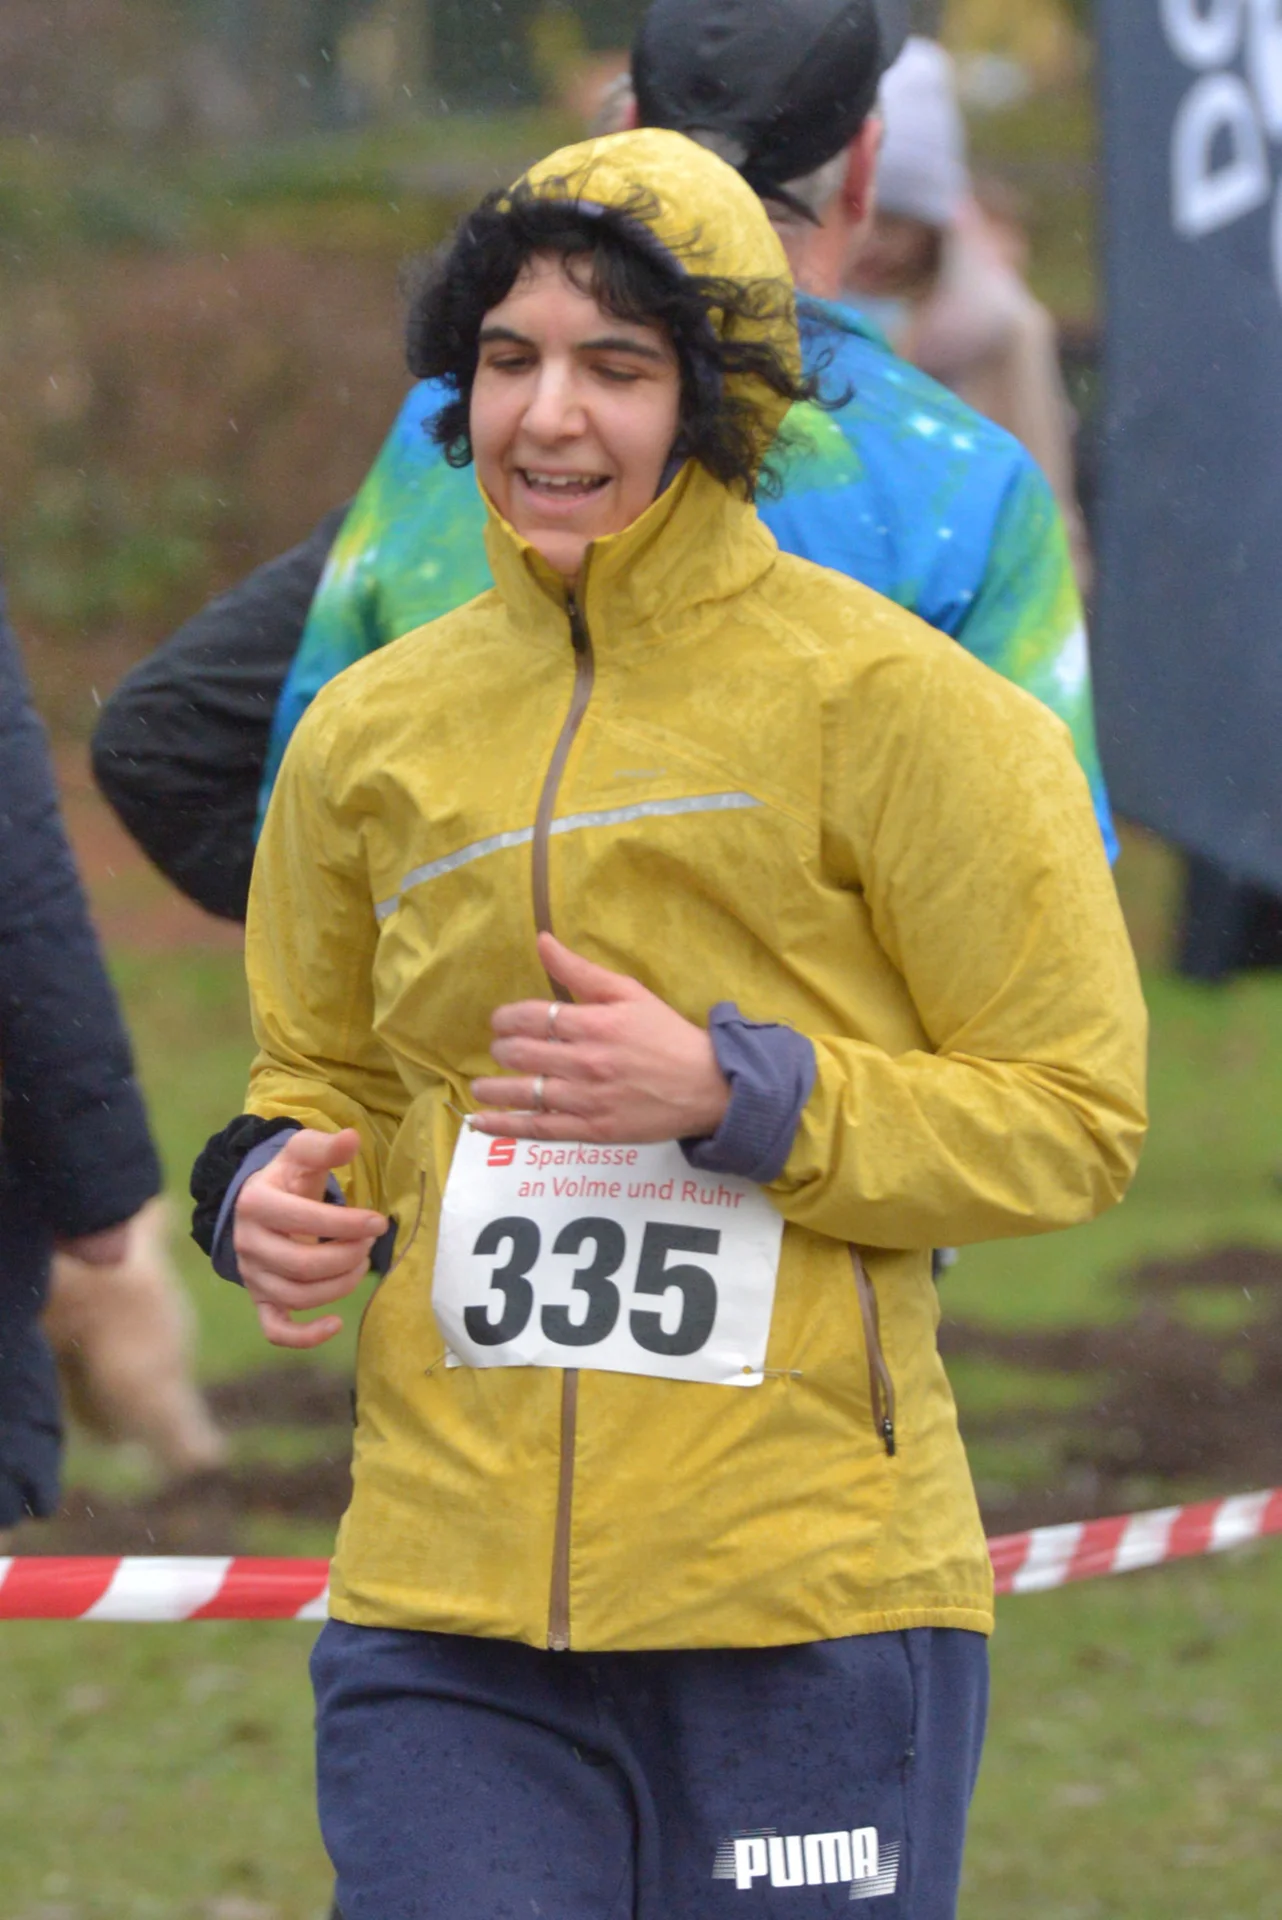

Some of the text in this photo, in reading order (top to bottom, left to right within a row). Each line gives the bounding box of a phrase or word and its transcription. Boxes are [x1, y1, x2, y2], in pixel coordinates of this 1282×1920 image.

[525, 1143, 639, 1170] Sparkasse
[518, 1177, 746, 1209] an Volme und Ruhr
[464, 1216, 721, 1357] 335
[733, 1826, 879, 1890] PUMA
